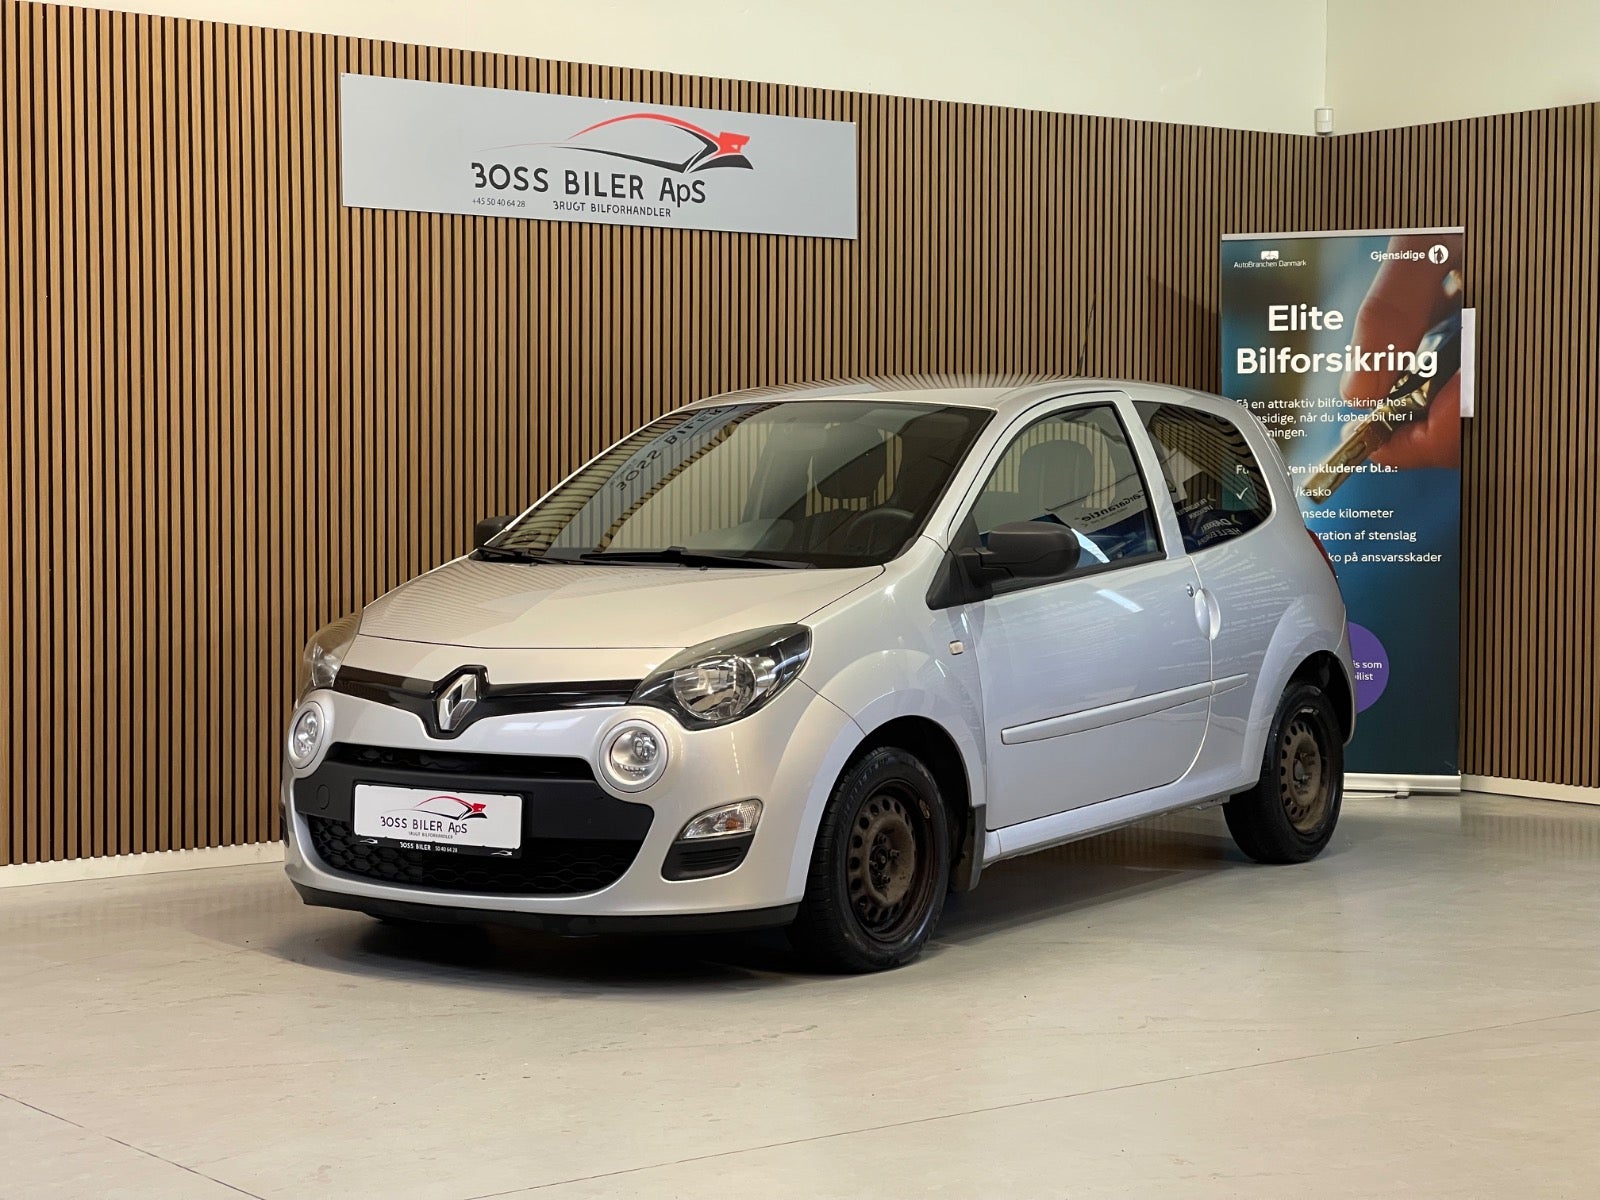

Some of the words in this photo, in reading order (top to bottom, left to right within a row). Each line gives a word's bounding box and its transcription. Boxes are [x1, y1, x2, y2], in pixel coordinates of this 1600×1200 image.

[564, 169, 644, 200] BILER
[659, 177, 706, 208] ApS
[486, 198, 496, 206] 50
[496, 199, 506, 207] 40
[516, 200, 526, 208] 28
[590, 203, 671, 217] BILFORHANDLER
[1370, 249, 1426, 262] Gjensidige
[1233, 260, 1278, 269] AutoBranchen
[1278, 259, 1307, 268] Danmark
[1268, 303, 1344, 332] Elite
[1236, 343, 1439, 378] Bilforsikring
[1251, 401, 1265, 409] en
[1267, 399, 1315, 409] attraktiv
[1317, 397, 1384, 411] bilforsikring
[1386, 397, 1407, 407] hos
[1299, 412, 1318, 423] når
[1321, 412, 1334, 422] du
[1337, 411, 1369, 422] køber
[1371, 411, 1386, 421] bil
[1388, 411, 1407, 421] her
[1308, 463, 1368, 474] inkluderer
[1370, 463, 1398, 473] bl.a.:
[1339, 508, 1394, 518] kilometer
[1354, 530, 1366, 540] af
[1368, 529, 1417, 542] stenslag
[1344, 552, 1359, 564] på
[1361, 551, 1442, 562] ansvarsskader
[413, 819, 442, 831] BILER
[448, 823, 468, 835] ApS
[416, 843, 431, 851] BILER
